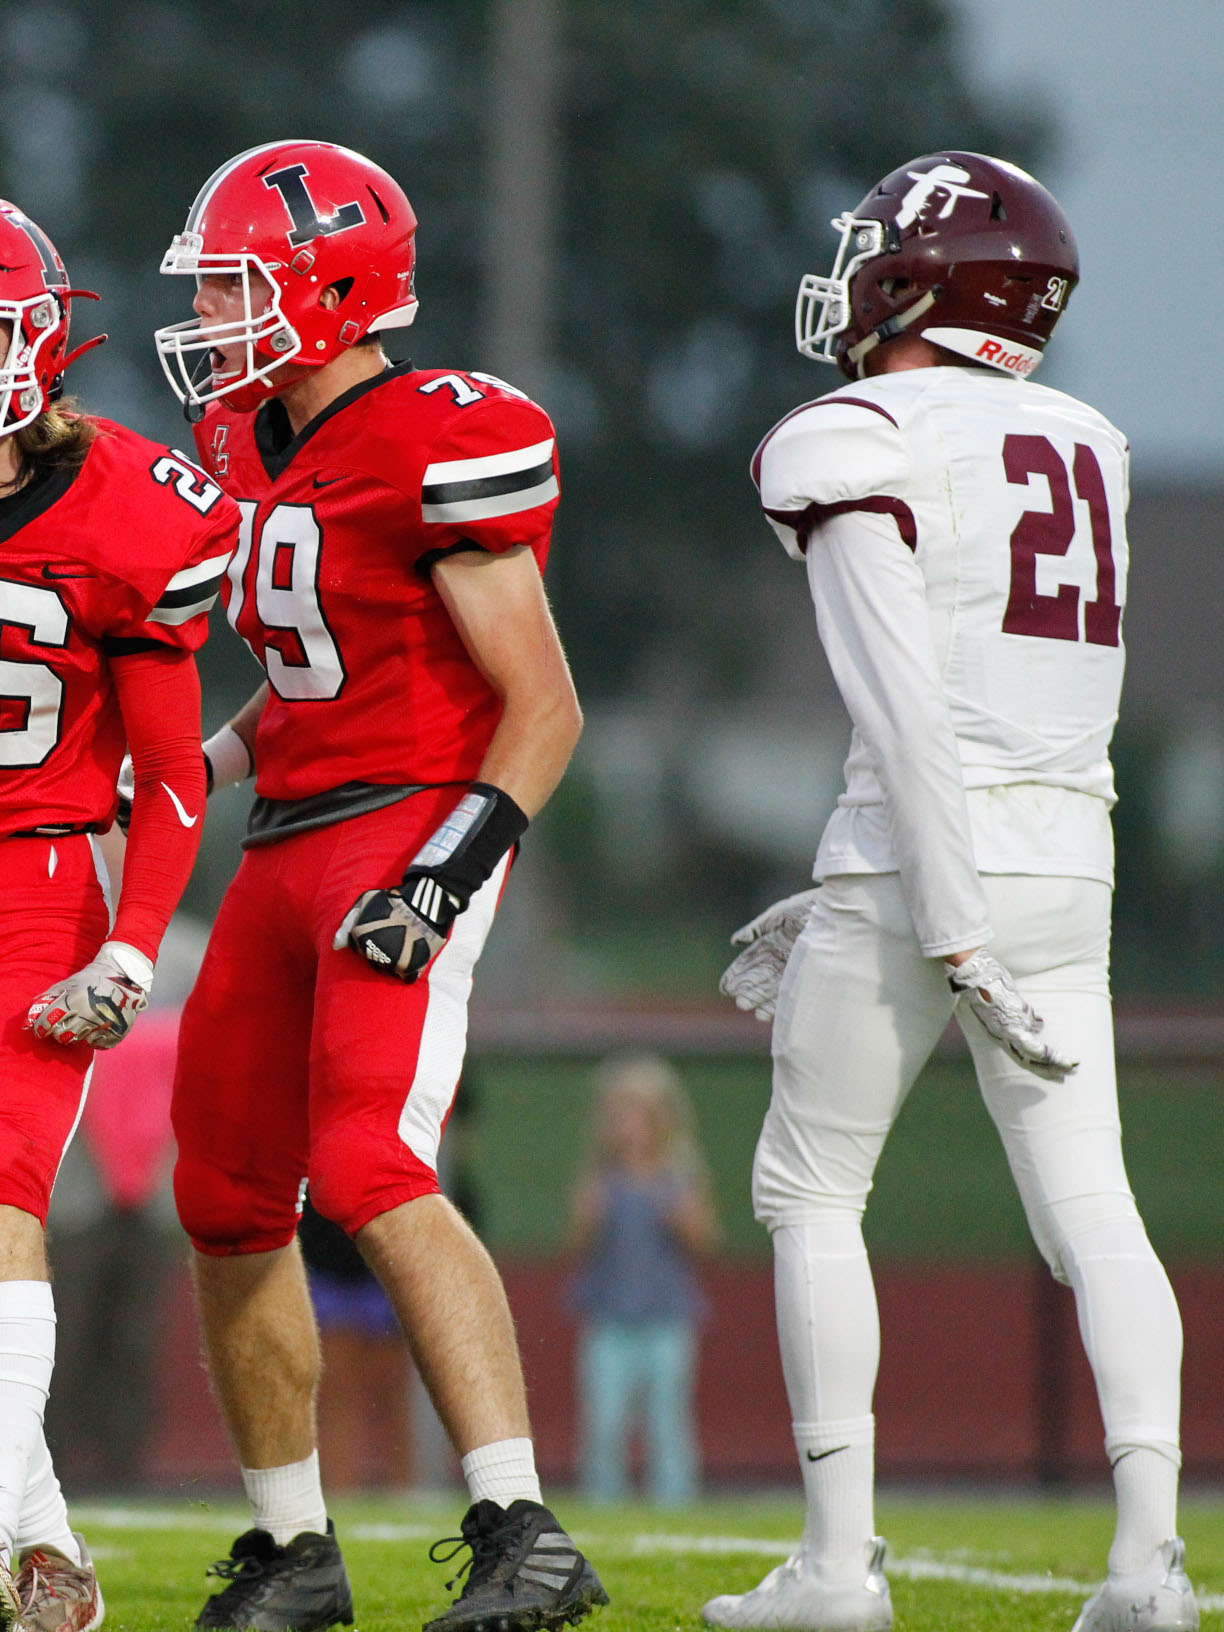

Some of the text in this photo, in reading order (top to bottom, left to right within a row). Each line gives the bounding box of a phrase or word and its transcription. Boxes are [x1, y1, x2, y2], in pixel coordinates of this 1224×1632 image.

[262, 163, 367, 249] L
[1041, 276, 1068, 312] 21
[1001, 434, 1121, 648] 21
